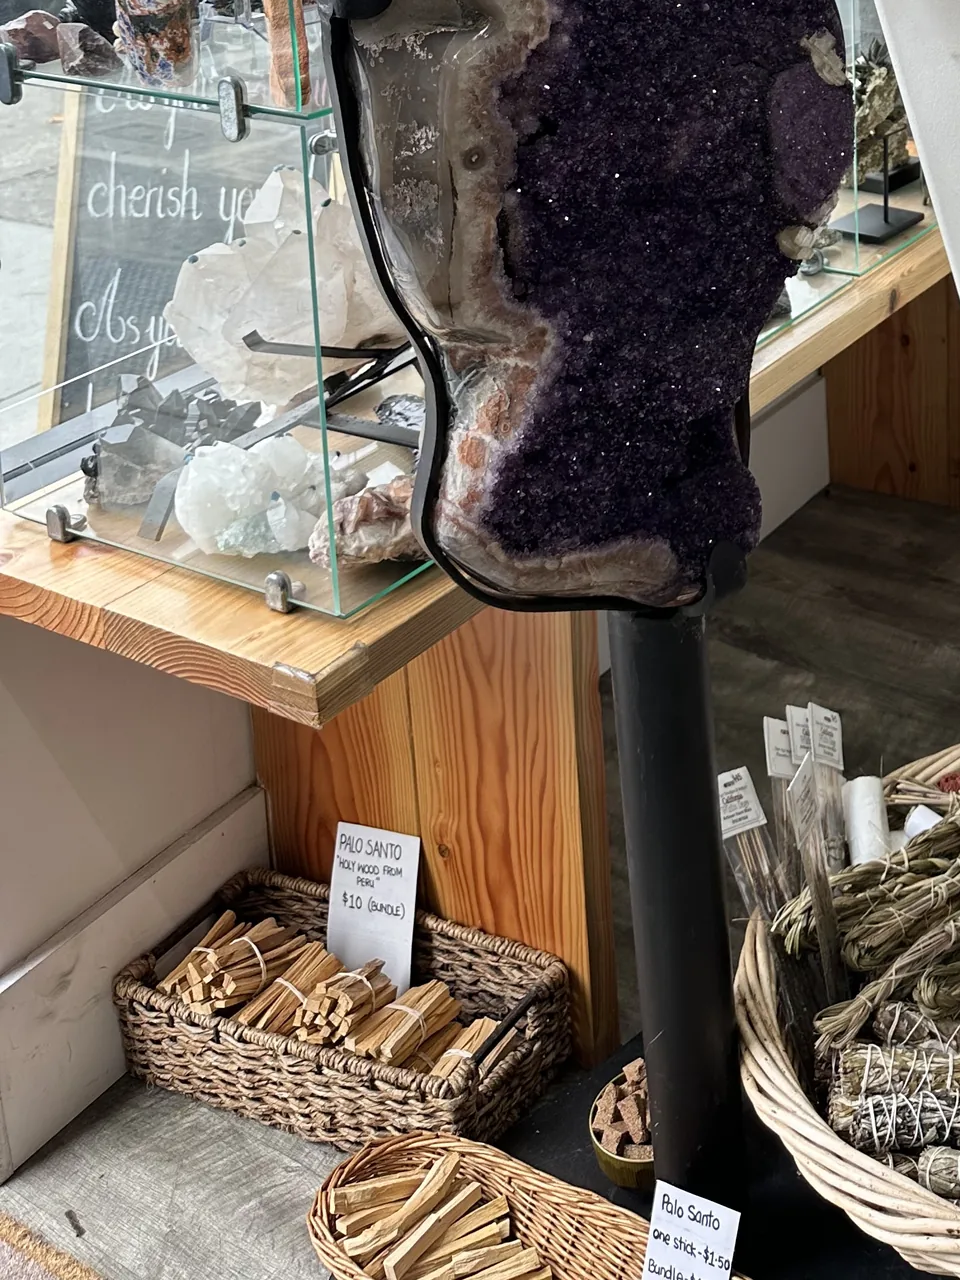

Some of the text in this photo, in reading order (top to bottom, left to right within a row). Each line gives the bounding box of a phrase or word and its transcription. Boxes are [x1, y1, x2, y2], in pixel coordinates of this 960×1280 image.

[87, 149, 202, 219] cherish
[339, 833, 402, 860] PALO SANTO
[358, 862, 379, 875] WOOD
[383, 865, 403, 877] FROM
[342, 890, 405, 920] $10 (BUNDLE)
[662, 1193, 720, 1230] Palo Santo
[653, 1228, 671, 1245] one
